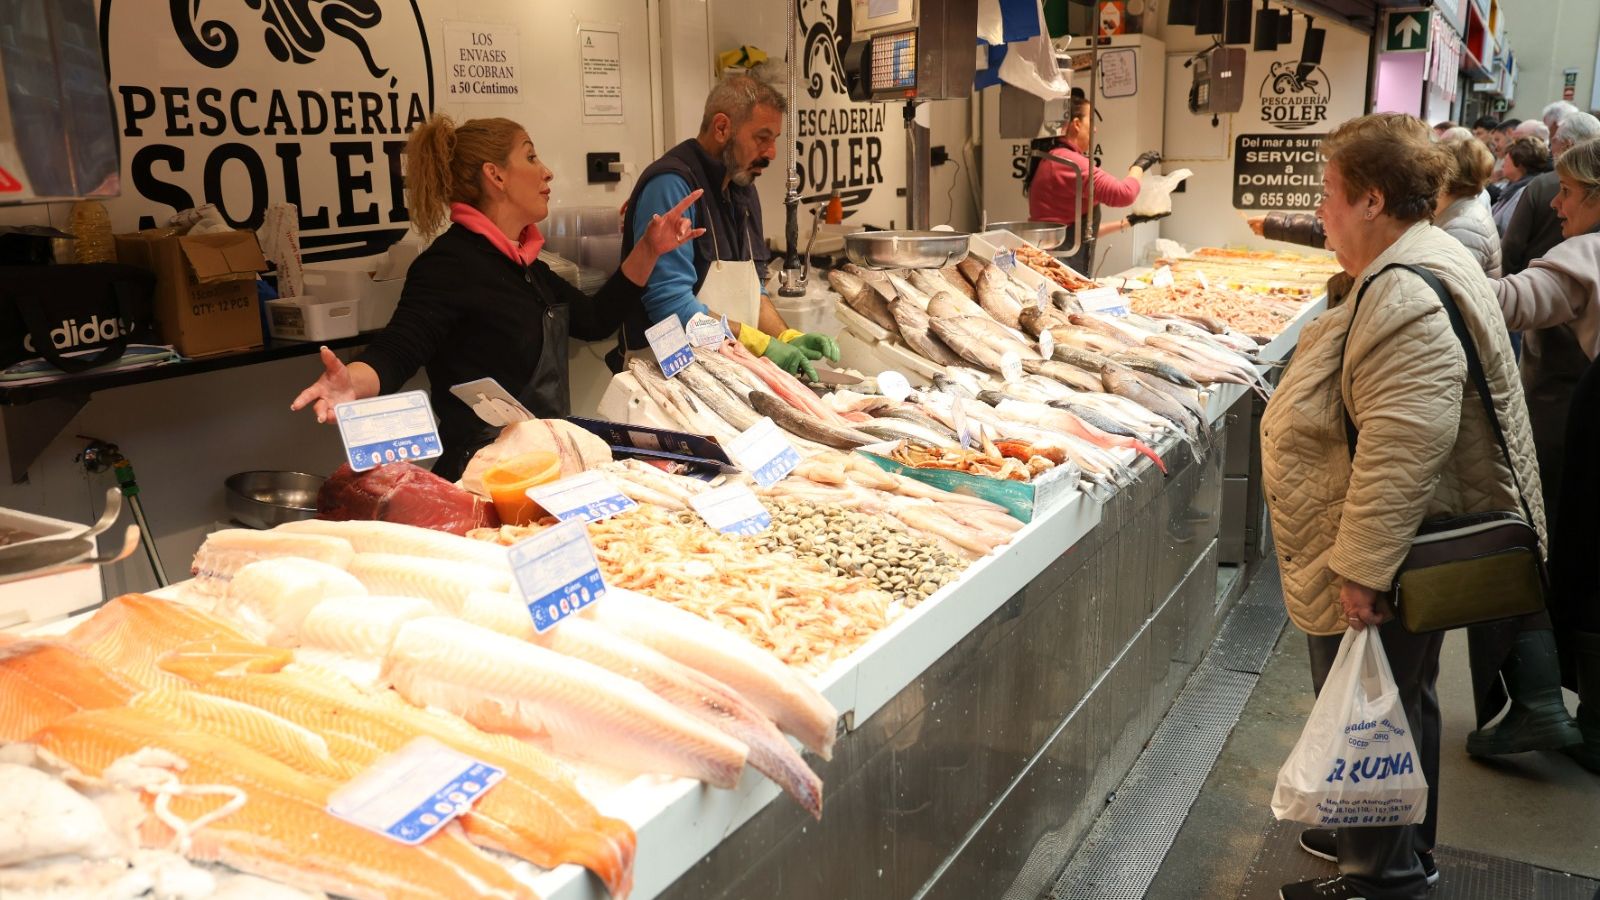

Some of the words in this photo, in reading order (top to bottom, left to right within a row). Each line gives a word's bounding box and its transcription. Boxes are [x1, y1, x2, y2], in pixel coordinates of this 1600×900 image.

[472, 32, 493, 46] LOS
[459, 48, 507, 63] ENVASES
[453, 64, 466, 78] SE
[468, 64, 514, 79] COBRAN
[450, 84, 457, 94] a
[459, 81, 471, 94] 50
[472, 80, 519, 95] Céntimos
[118, 76, 428, 137] PESCADERÍA
[1261, 94, 1329, 106] PESCADERÍA
[798, 102, 884, 137] ESCADERÍA
[1260, 105, 1328, 121] SOLER
[1241, 137, 1261, 148] Del
[1262, 138, 1284, 148] mar
[1286, 139, 1294, 148] a
[1296, 139, 1309, 148] su
[1284, 164, 1294, 174] a
[1260, 193, 1284, 207] 655
[1286, 193, 1311, 207] 990
[192, 302, 215, 317] QTY:
[218, 300, 228, 312] 12
[231, 296, 250, 310] PCS
